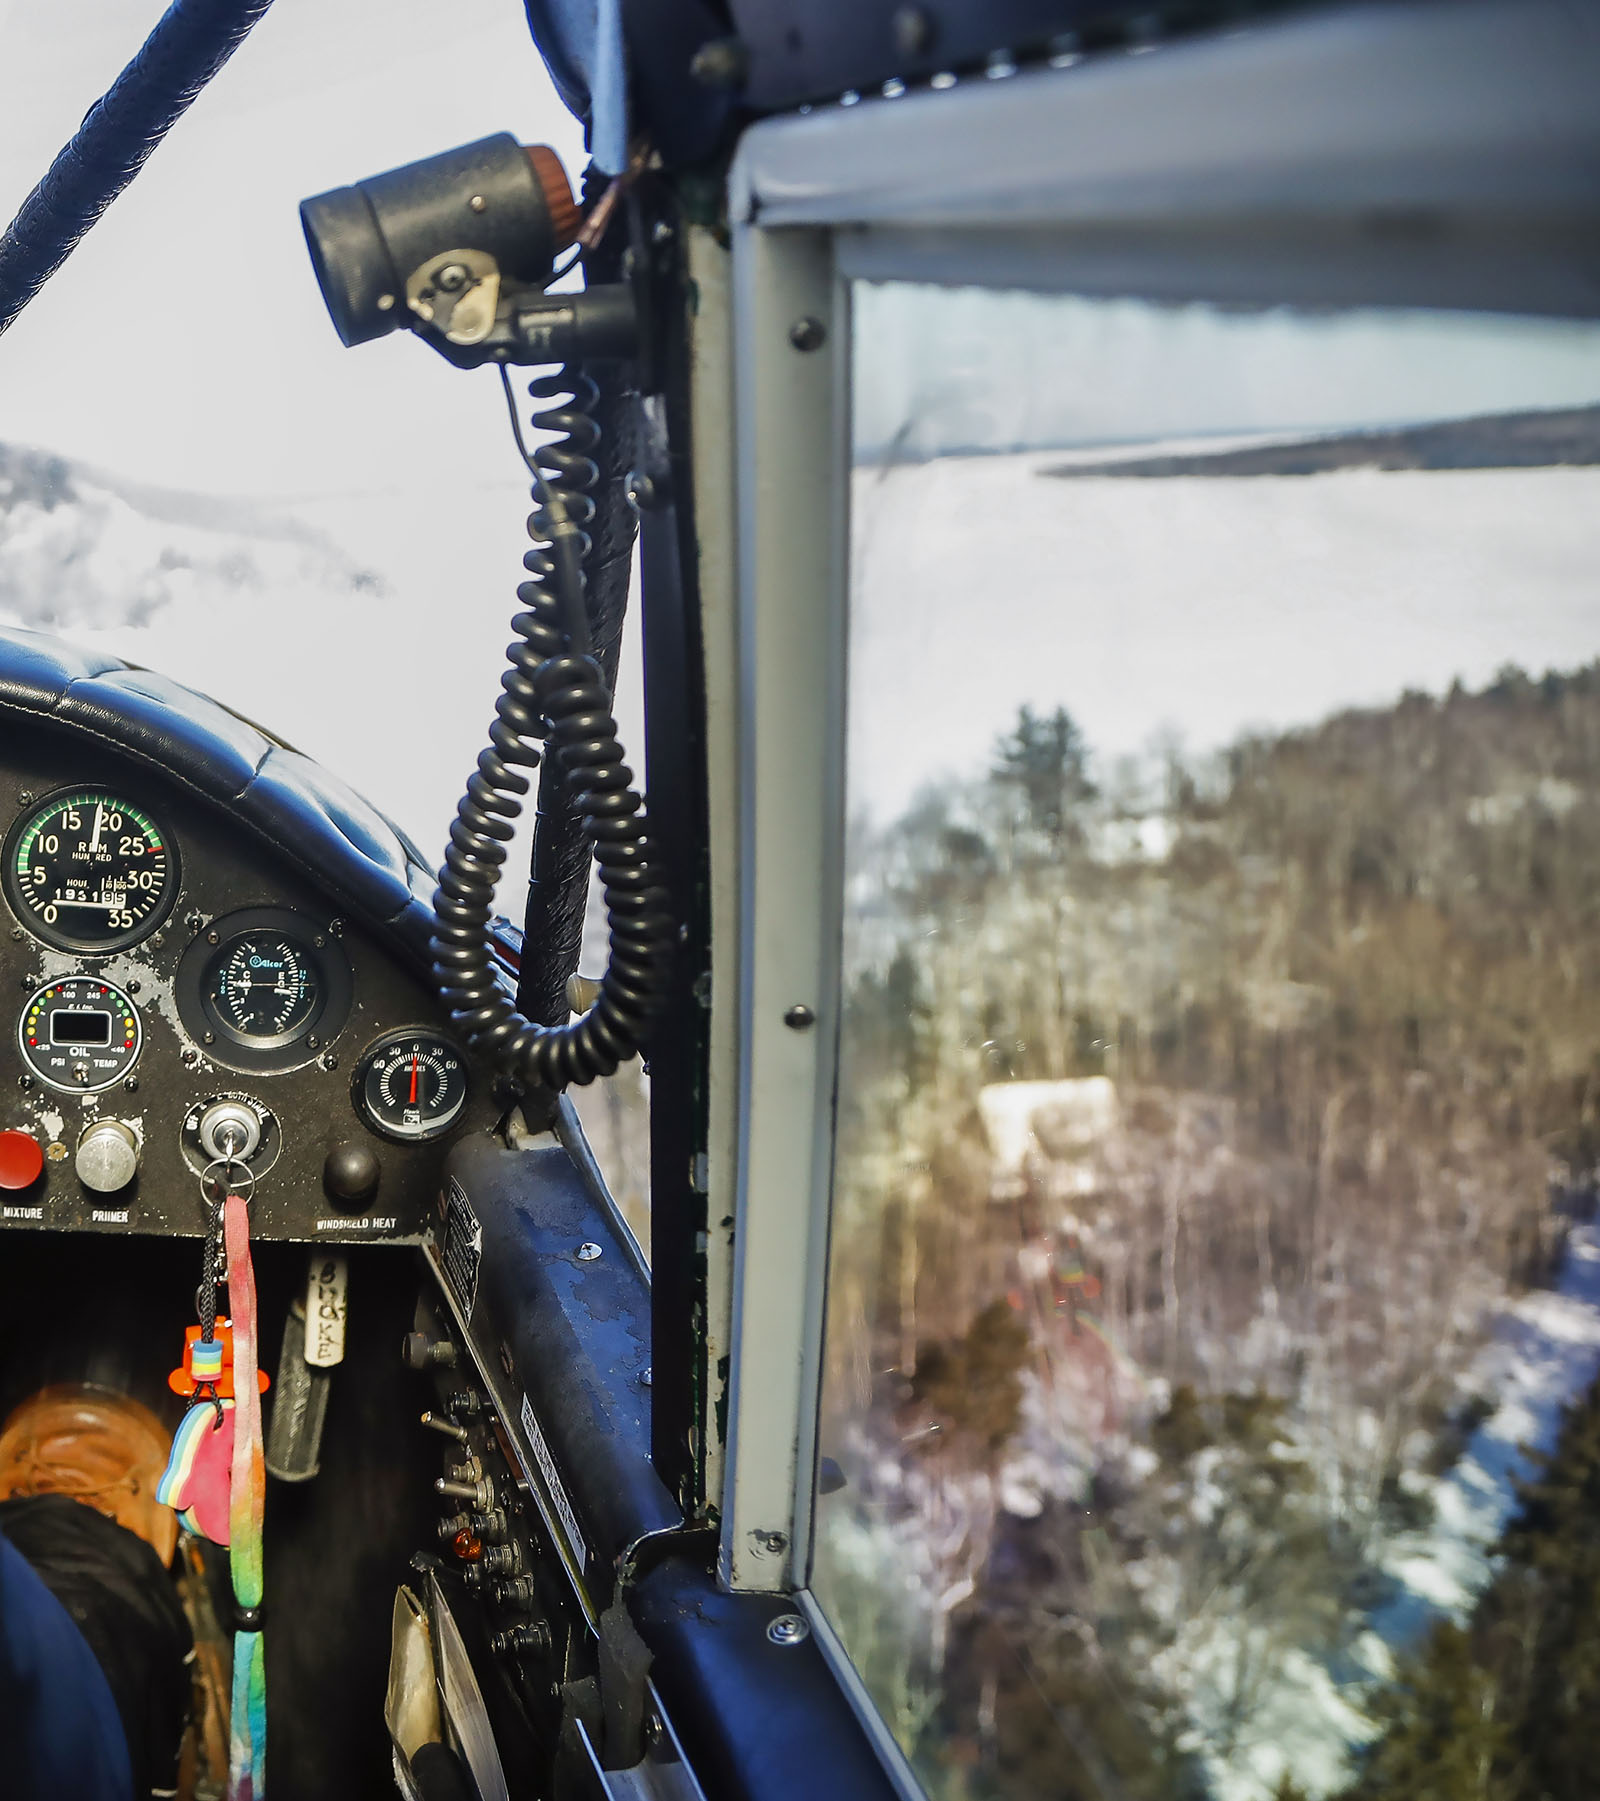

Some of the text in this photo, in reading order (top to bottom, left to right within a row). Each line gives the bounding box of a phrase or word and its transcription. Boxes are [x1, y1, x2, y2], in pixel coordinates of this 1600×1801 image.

[62, 811, 82, 830] 15
[100, 813, 123, 832] 20
[38, 834, 59, 854] 10
[118, 836, 145, 856] 25
[71, 852, 112, 862] HUNRED
[33, 866, 47, 885] 5
[126, 870, 153, 890] 30
[43, 904, 58, 924] 0
[107, 908, 134, 929] 35
[260, 960, 283, 968] Alcor
[69, 1047, 91, 1057] OIL
[389, 1047, 401, 1056] 30
[413, 1043, 419, 1052] 0
[431, 1047, 443, 1056] 30
[50, 1058, 65, 1066] PSI
[93, 1059, 118, 1068] TEMP
[373, 1059, 386, 1069] 60
[445, 1060, 457, 1070] 60
[3, 1207, 43, 1219] MIXTURE
[373, 1218, 397, 1229] HEAT
